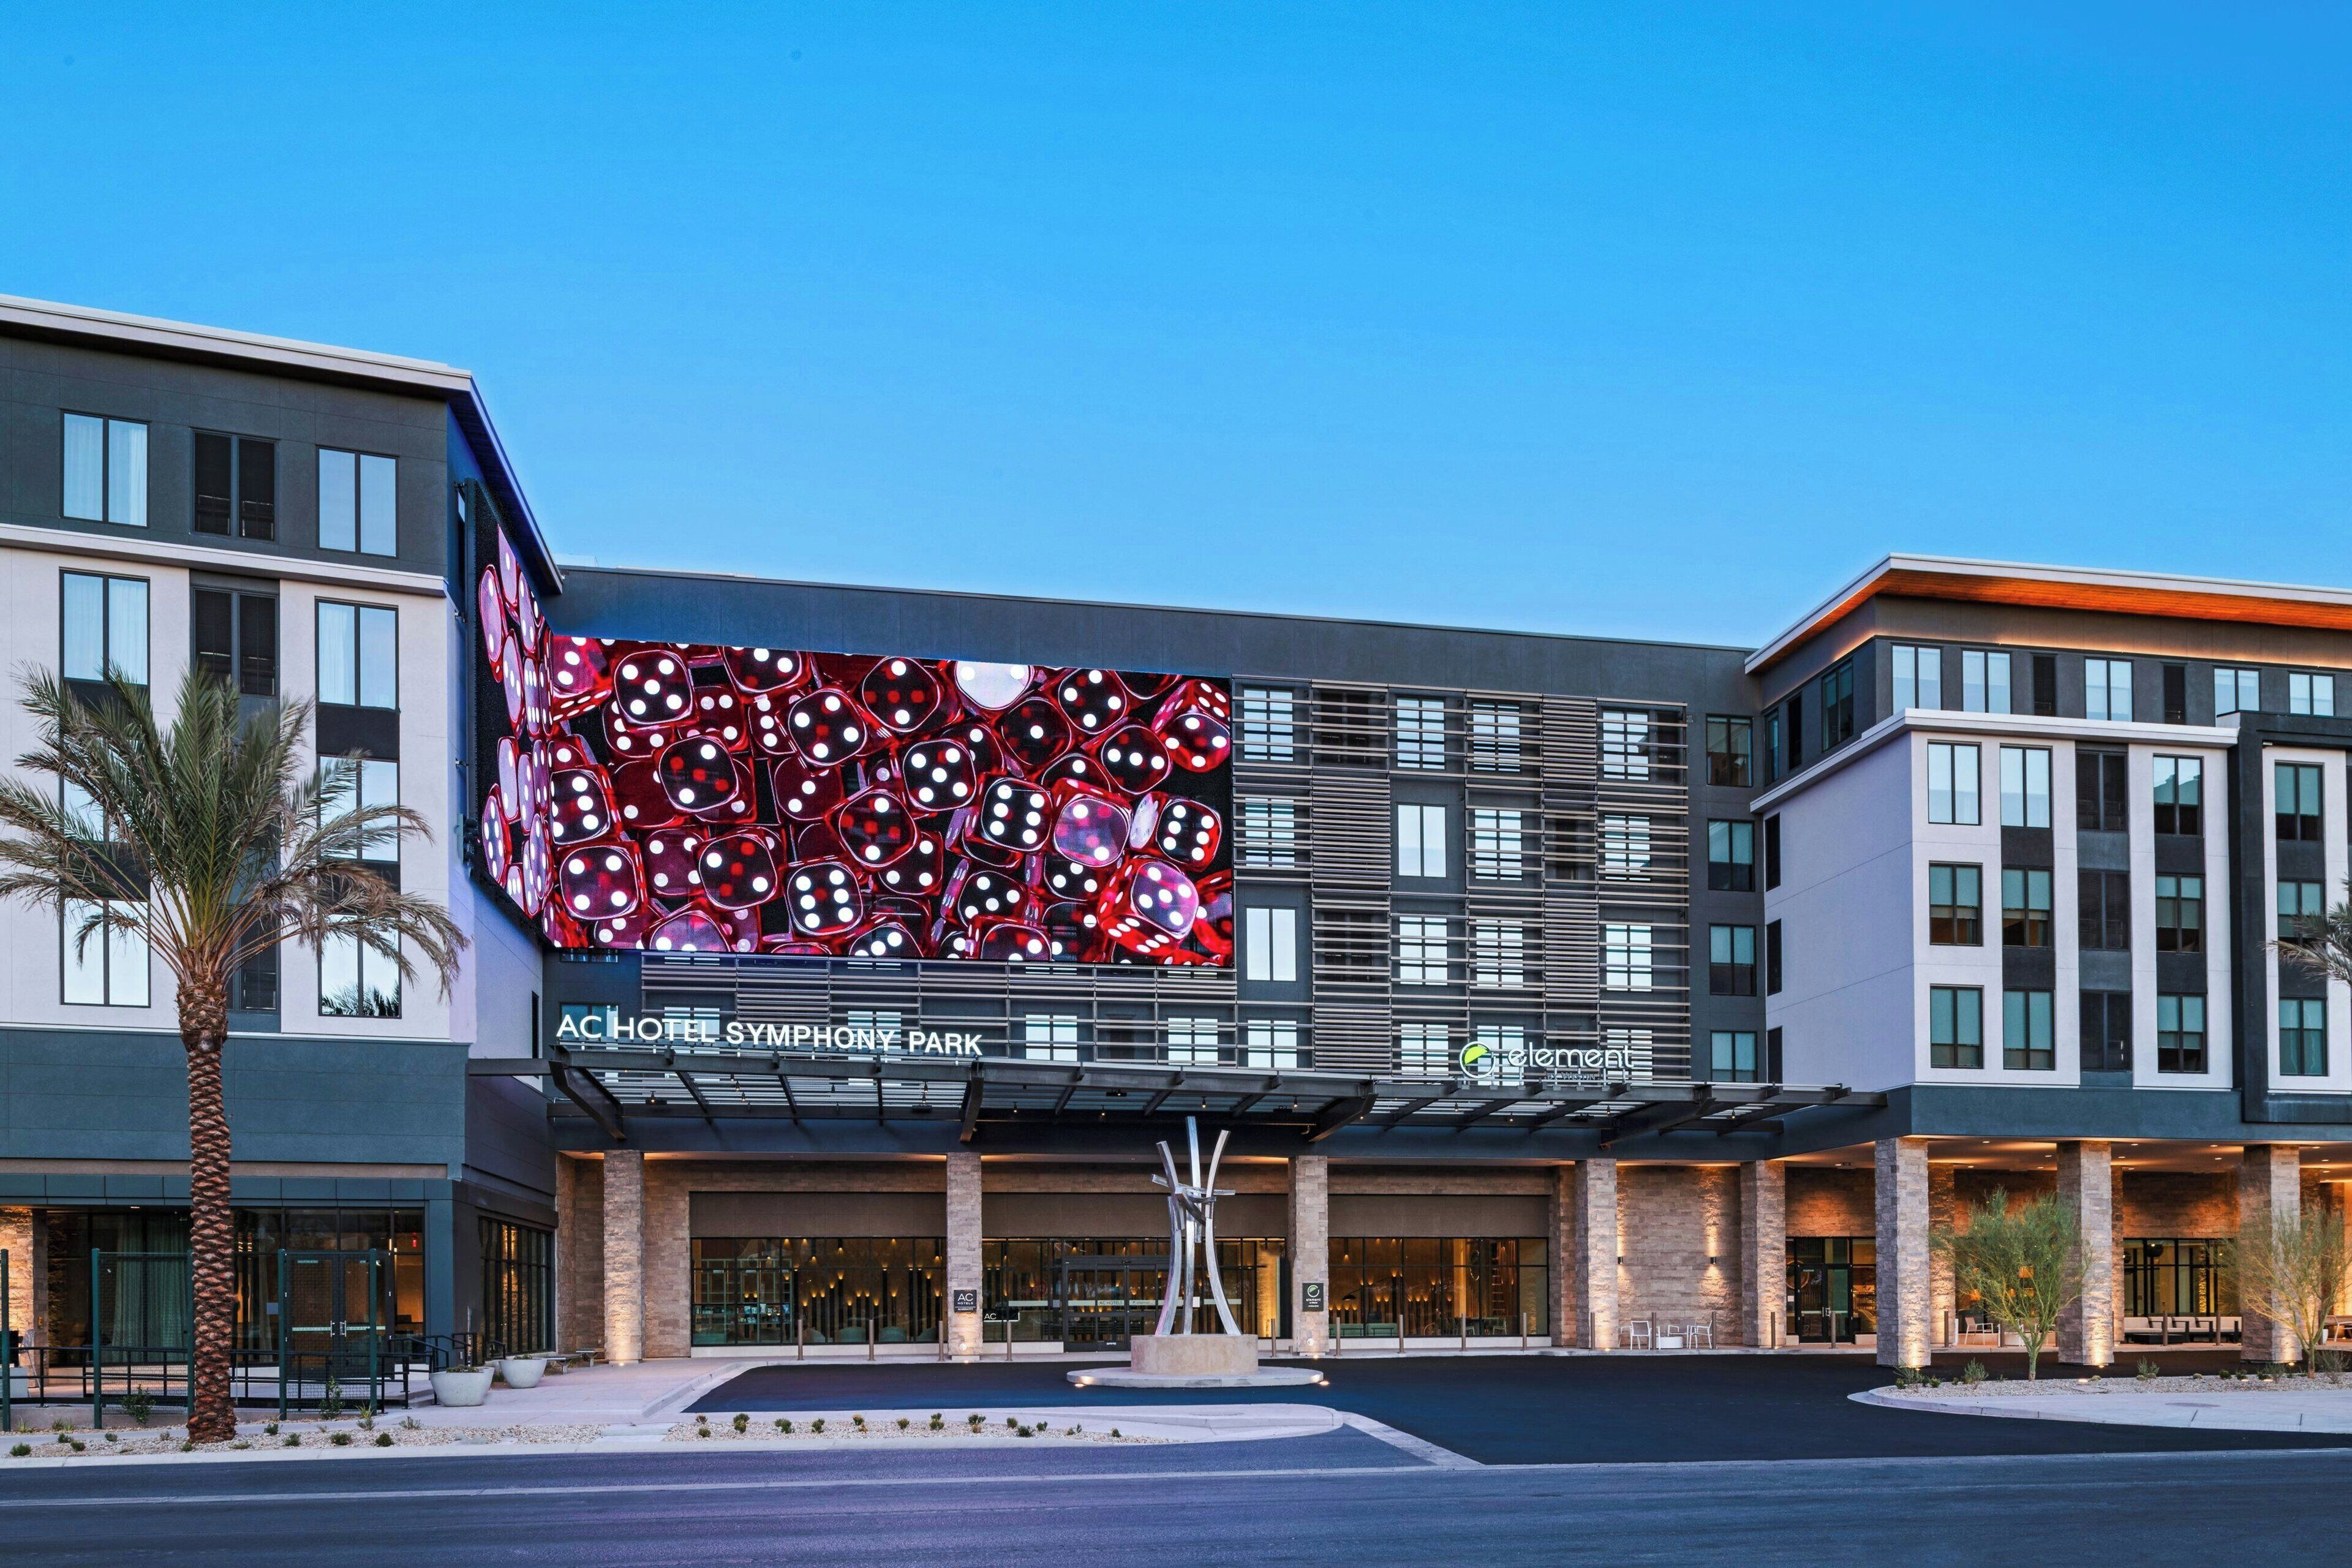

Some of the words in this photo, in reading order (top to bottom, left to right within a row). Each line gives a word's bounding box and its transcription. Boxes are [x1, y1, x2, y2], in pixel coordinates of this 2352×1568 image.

[556, 1014, 602, 1038] AC
[614, 1017, 715, 1043] HOTEL
[725, 1022, 895, 1052] SYMPHONY
[909, 1031, 982, 1055] PARK
[1507, 1042, 1634, 1068] element
[1561, 1072, 1596, 1080] WESTIN
[957, 1293, 973, 1302] AC
